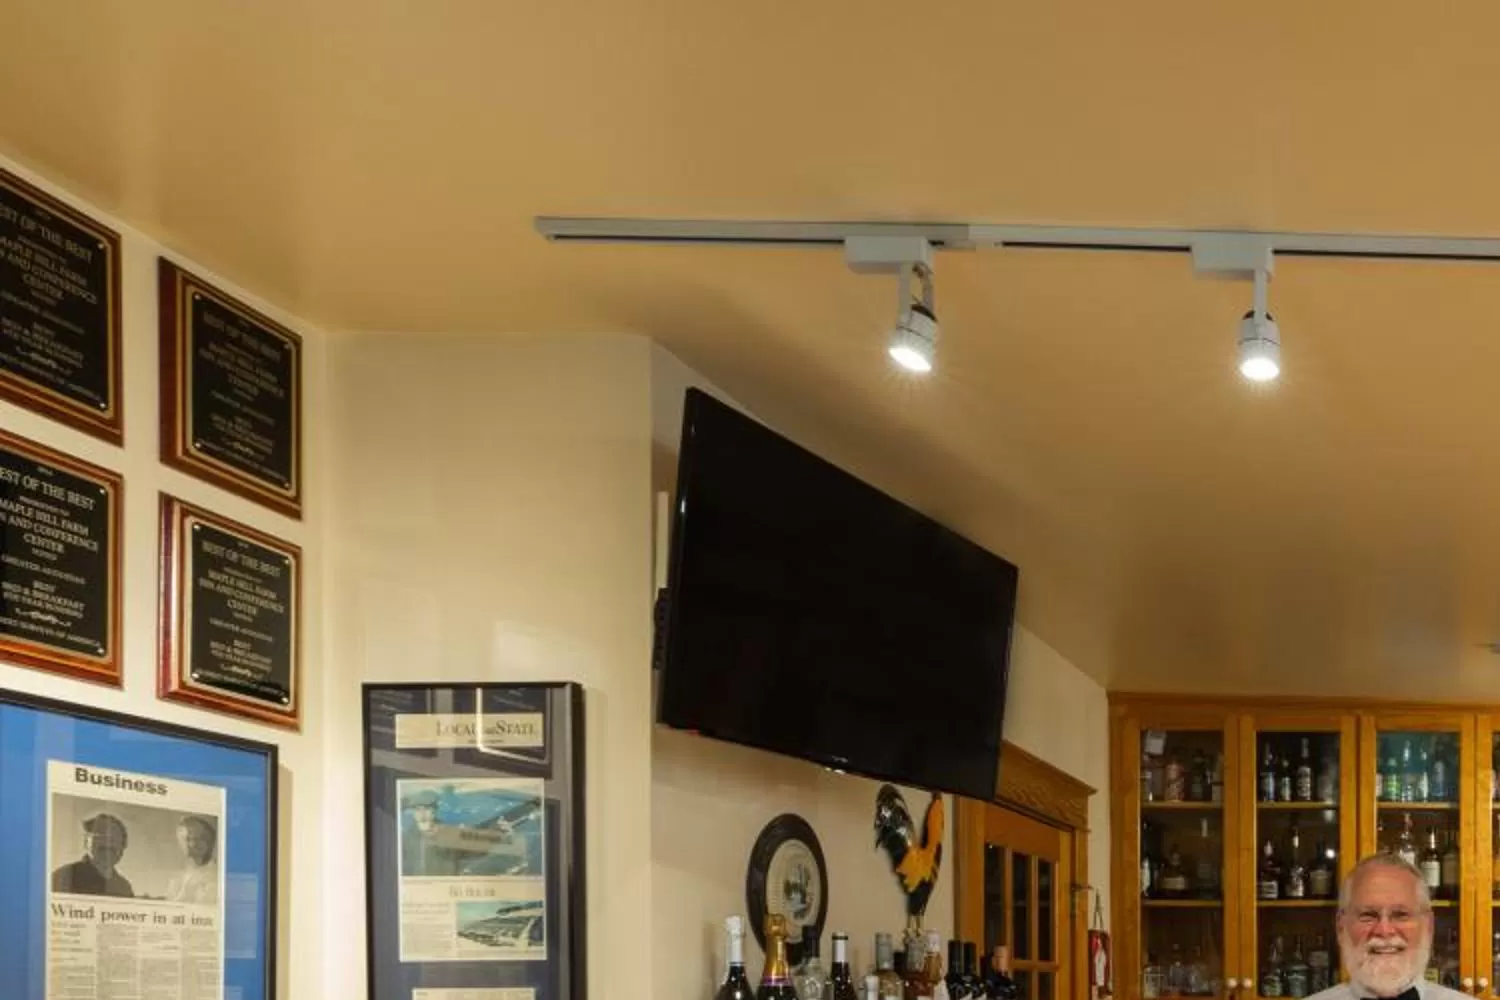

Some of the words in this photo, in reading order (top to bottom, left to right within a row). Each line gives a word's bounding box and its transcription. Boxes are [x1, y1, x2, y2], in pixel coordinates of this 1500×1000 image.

[74, 766, 169, 797] Business
[50, 902, 96, 921] Wind
[100, 909, 148, 925] power
[152, 910, 168, 925] in
